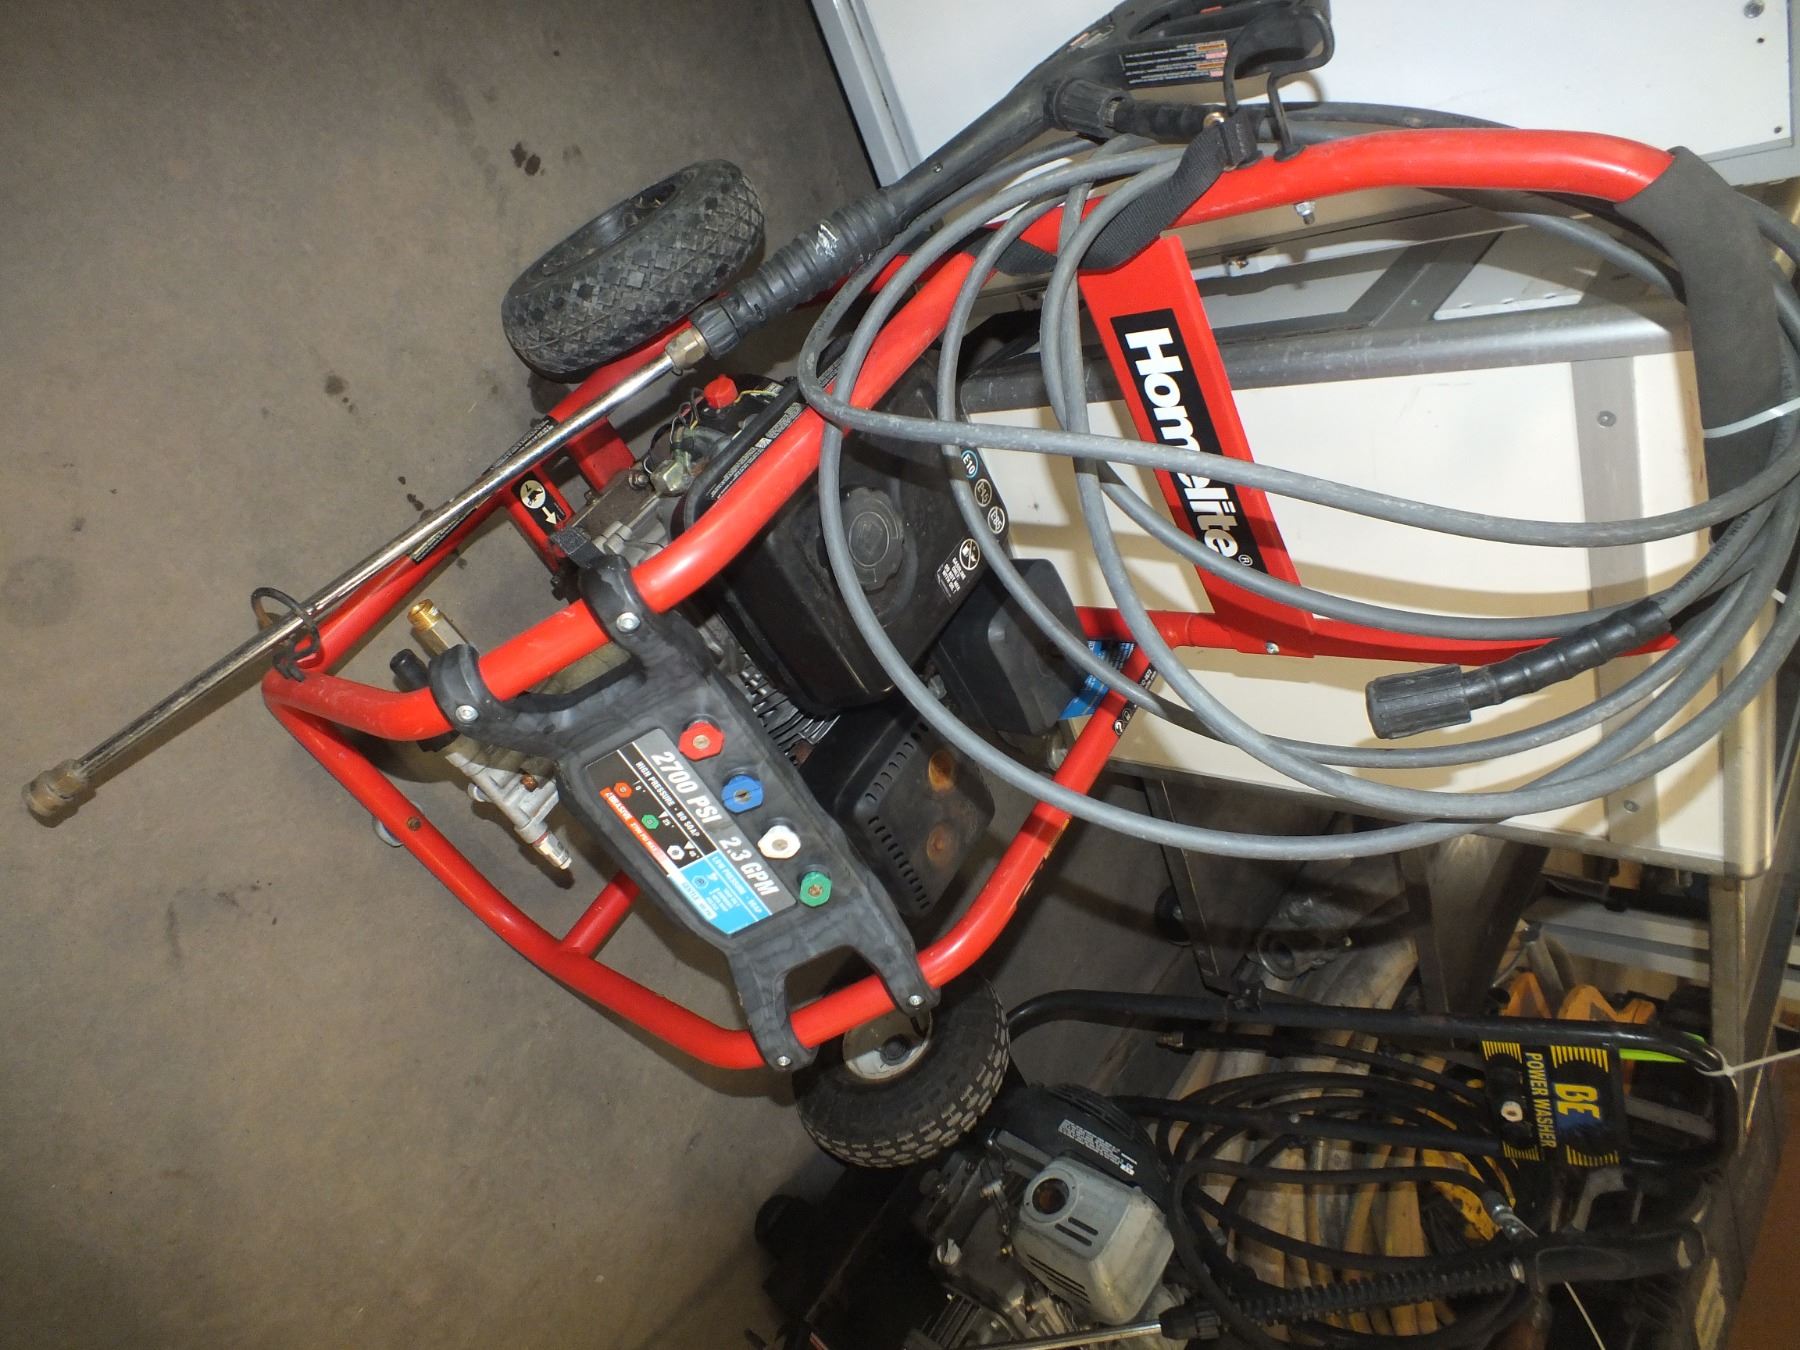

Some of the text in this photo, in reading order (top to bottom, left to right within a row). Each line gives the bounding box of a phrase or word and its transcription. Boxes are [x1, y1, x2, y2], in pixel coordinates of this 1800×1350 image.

[962, 453, 976, 475] E10
[635, 761, 700, 837] HIGH PRESSURE NO SOAP
[651, 751, 699, 794] 2700
[686, 795, 722, 824] PSI
[719, 836, 752, 862] 2.3
[740, 862, 780, 896] GPM
[1525, 1052, 1558, 1149] POWER WASHER
[1554, 1083, 1601, 1120] BE
